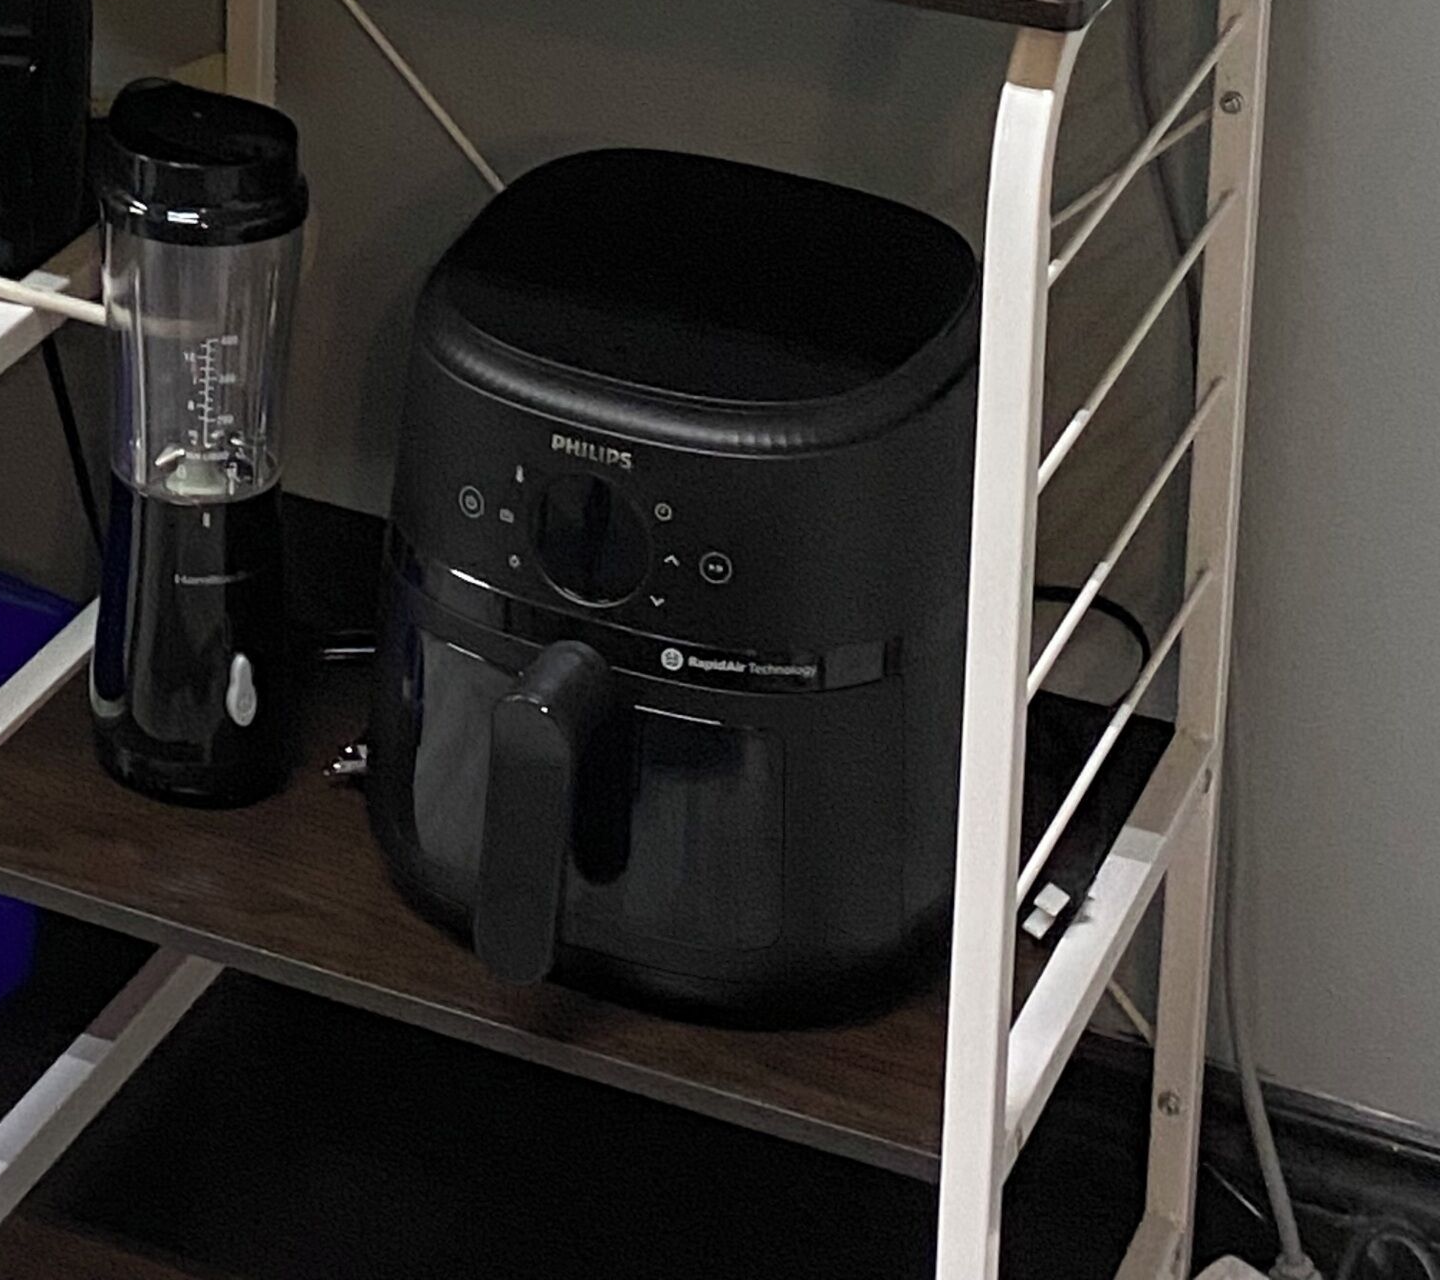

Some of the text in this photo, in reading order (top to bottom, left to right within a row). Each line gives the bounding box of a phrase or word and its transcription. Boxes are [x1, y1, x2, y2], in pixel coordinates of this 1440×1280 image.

[551, 433, 633, 469] PHILIPS
[688, 655, 817, 678] RapidAir Technology
